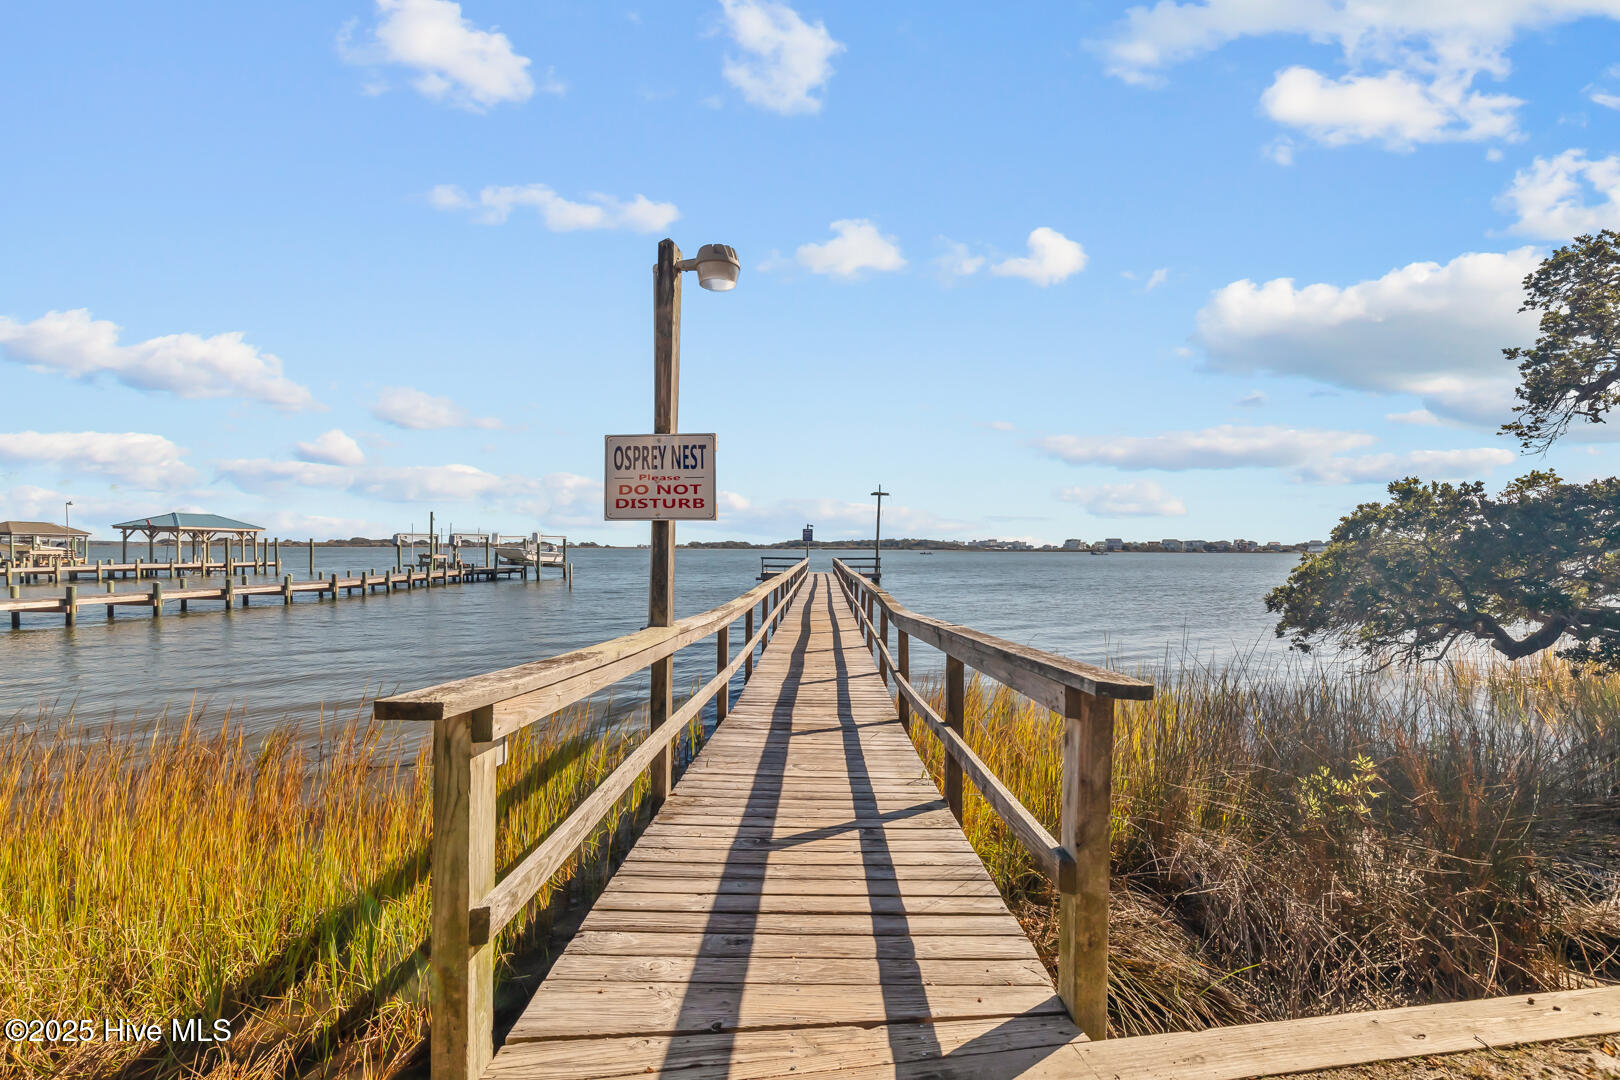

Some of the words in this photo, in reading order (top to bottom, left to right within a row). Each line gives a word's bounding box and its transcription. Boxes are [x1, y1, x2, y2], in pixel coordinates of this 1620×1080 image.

[614, 445, 666, 470] OSPREY
[671, 444, 706, 470] NEST
[618, 484, 649, 495] DO
[656, 484, 702, 495] NOT
[616, 498, 704, 508] DISTURB
